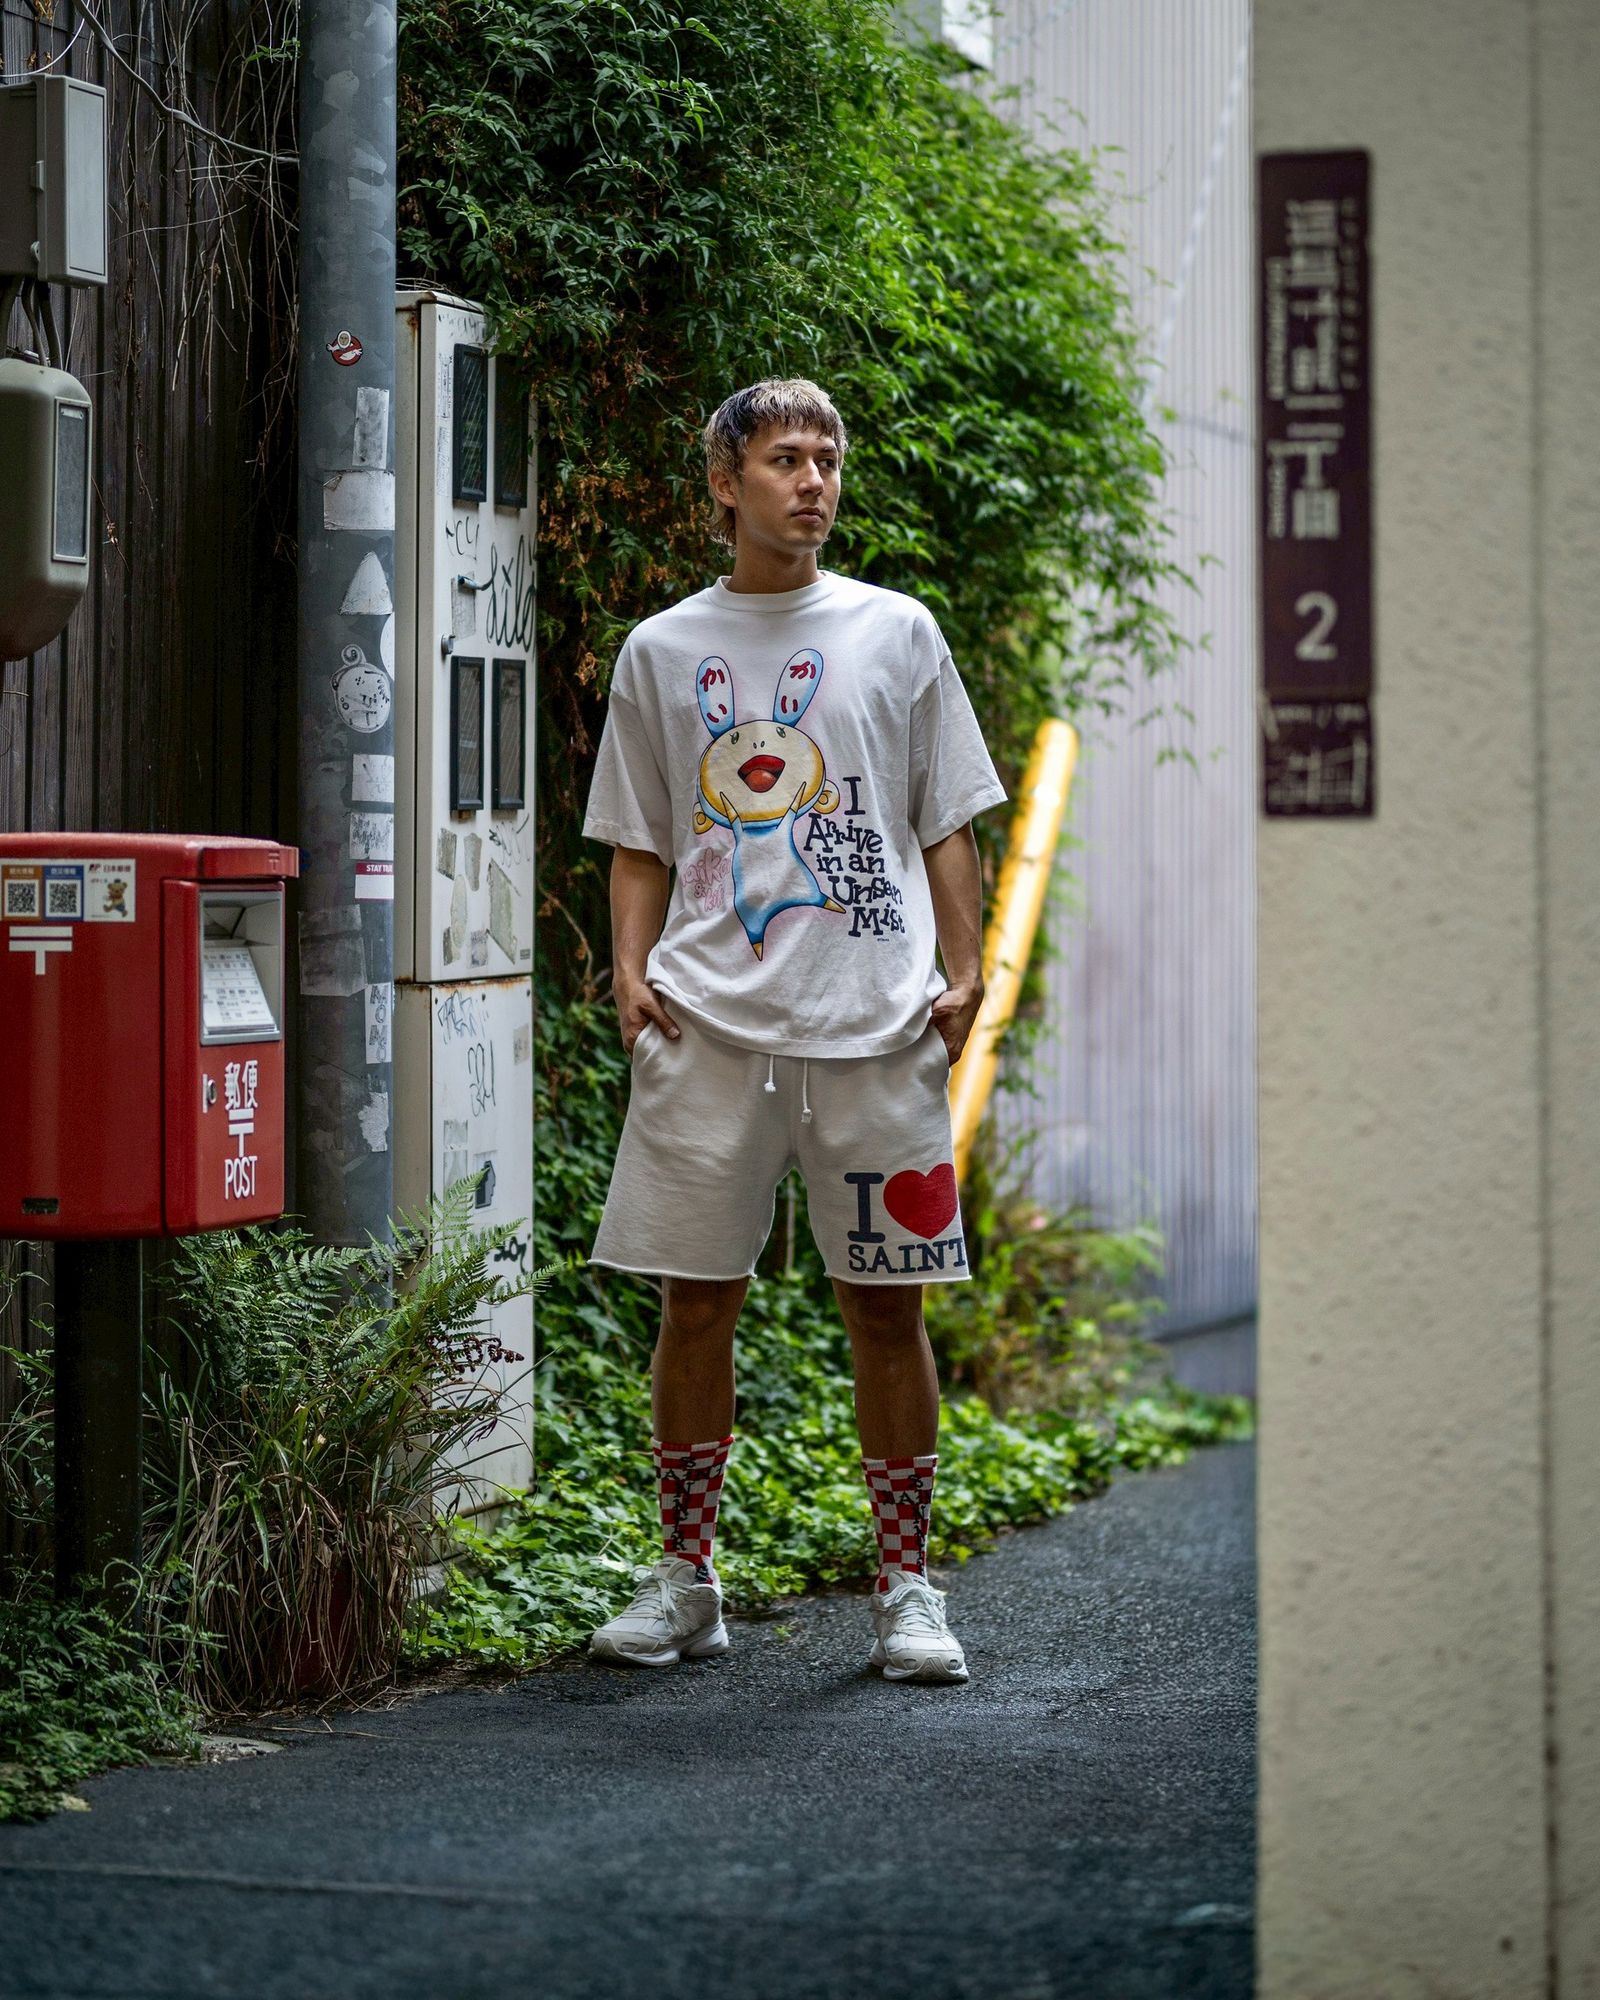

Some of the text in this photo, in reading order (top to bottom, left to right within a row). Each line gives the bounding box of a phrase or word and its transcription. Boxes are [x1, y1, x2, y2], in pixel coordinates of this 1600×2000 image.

[1295, 591, 1338, 661] 2
[843, 776, 865, 815] I
[803, 813, 883, 853] Arrive
[366, 864, 382, 873] STAY
[816, 853, 885, 874] in an
[828, 876, 903, 905] Unsen
[848, 903, 905, 937] Mist
[225, 1060, 258, 1110] 郵便
[225, 1156, 258, 1200] POST
[844, 1172, 885, 1243] I
[848, 1237, 966, 1273] SAINT
